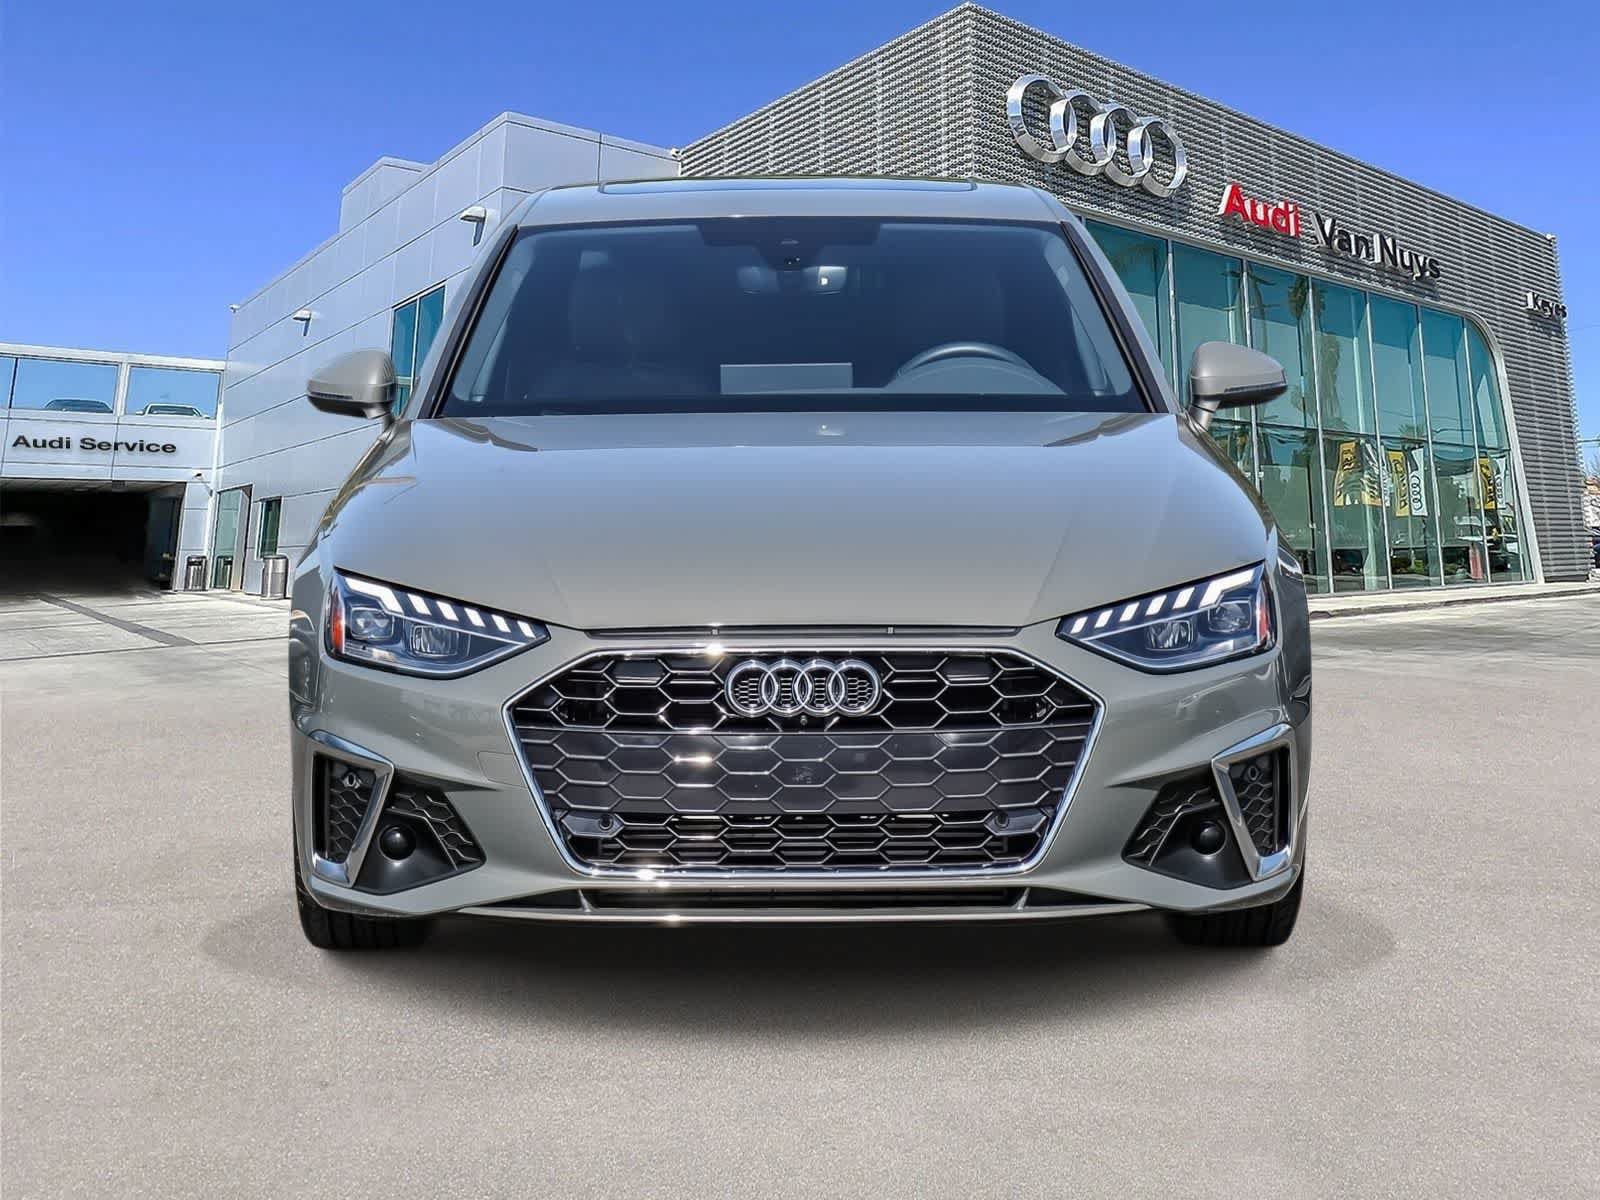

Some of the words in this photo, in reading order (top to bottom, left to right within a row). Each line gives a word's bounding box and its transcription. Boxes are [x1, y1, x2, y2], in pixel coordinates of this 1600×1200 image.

[1216, 182, 1301, 238] Audi
[1310, 213, 1371, 259] Van
[1373, 233, 1441, 280] Nuys
[1526, 291, 1568, 319] Keyes
[12, 435, 72, 449] Audi
[79, 437, 177, 453] Service
